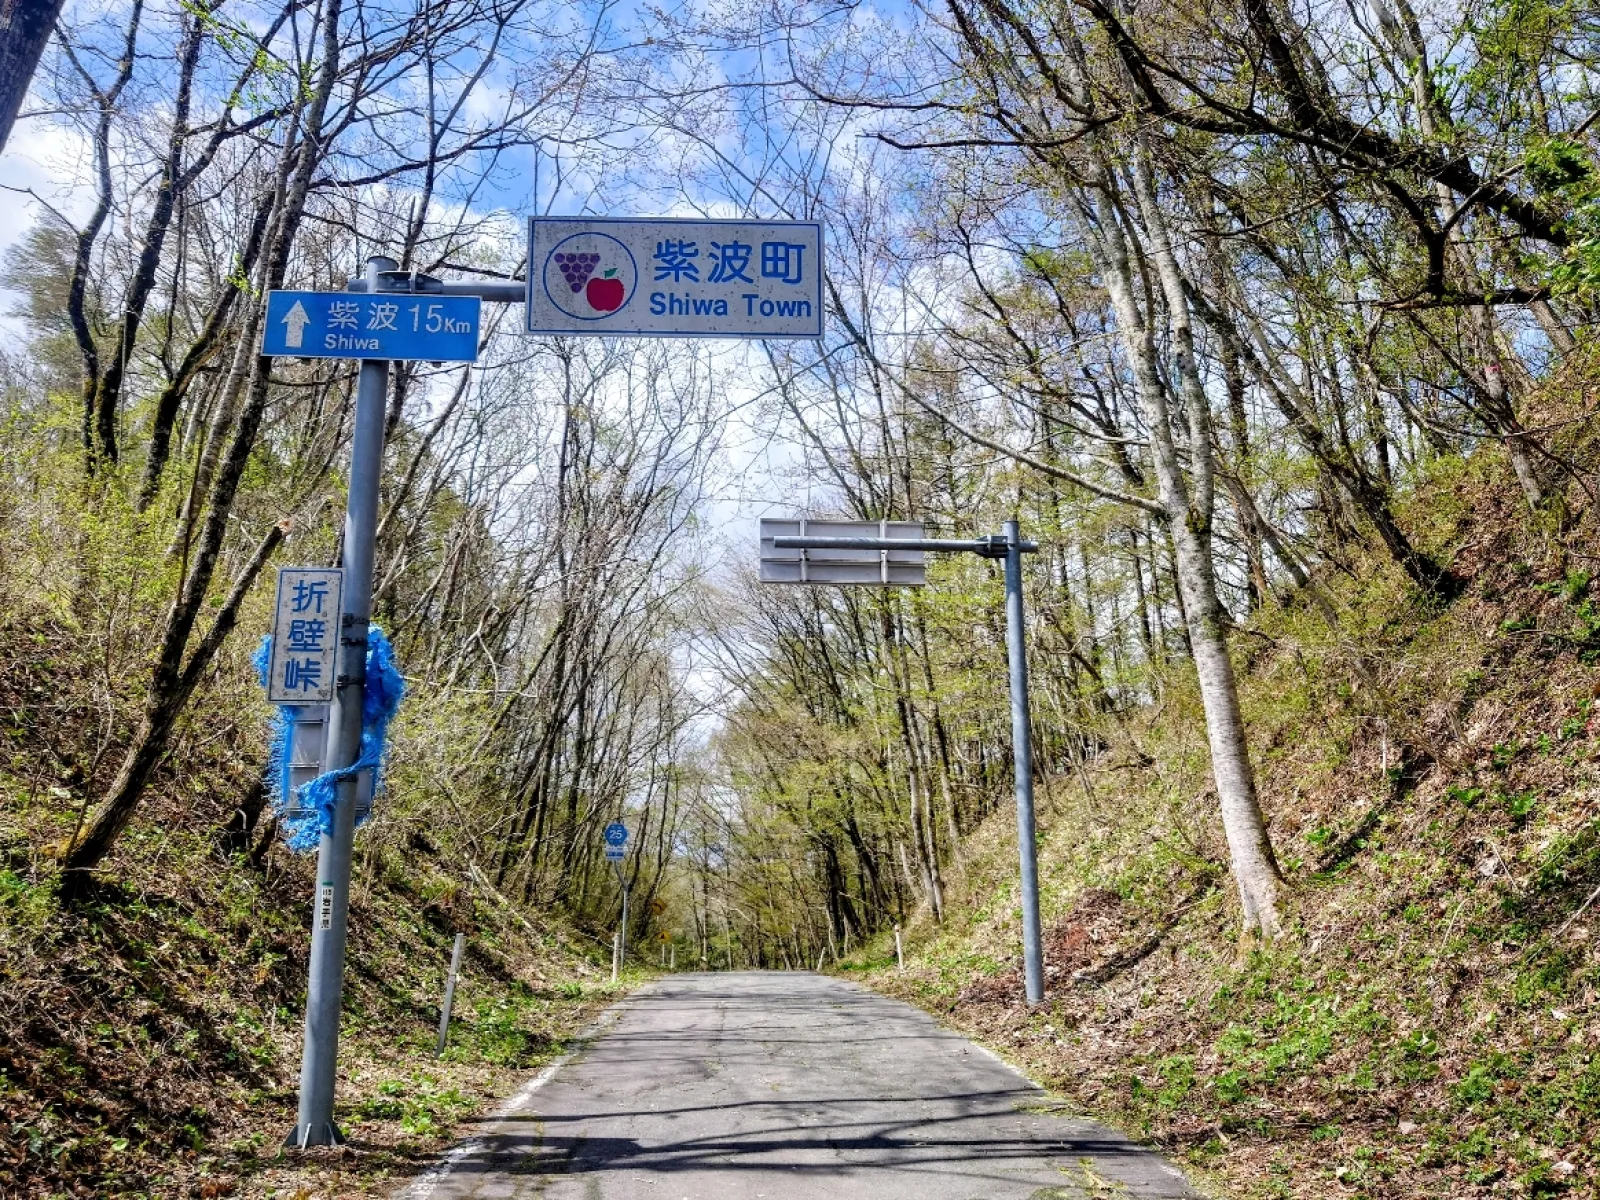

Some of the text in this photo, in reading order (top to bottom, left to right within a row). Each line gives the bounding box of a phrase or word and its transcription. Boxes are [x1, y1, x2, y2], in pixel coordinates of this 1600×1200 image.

[652, 239, 806, 285] 紫波町
[327, 300, 399, 331] 紫波
[650, 292, 812, 317] Shiwa Town
[324, 334, 380, 350] Shiwa
[284, 579, 329, 692] 折壁峠
[609, 829, 622, 839] 25
